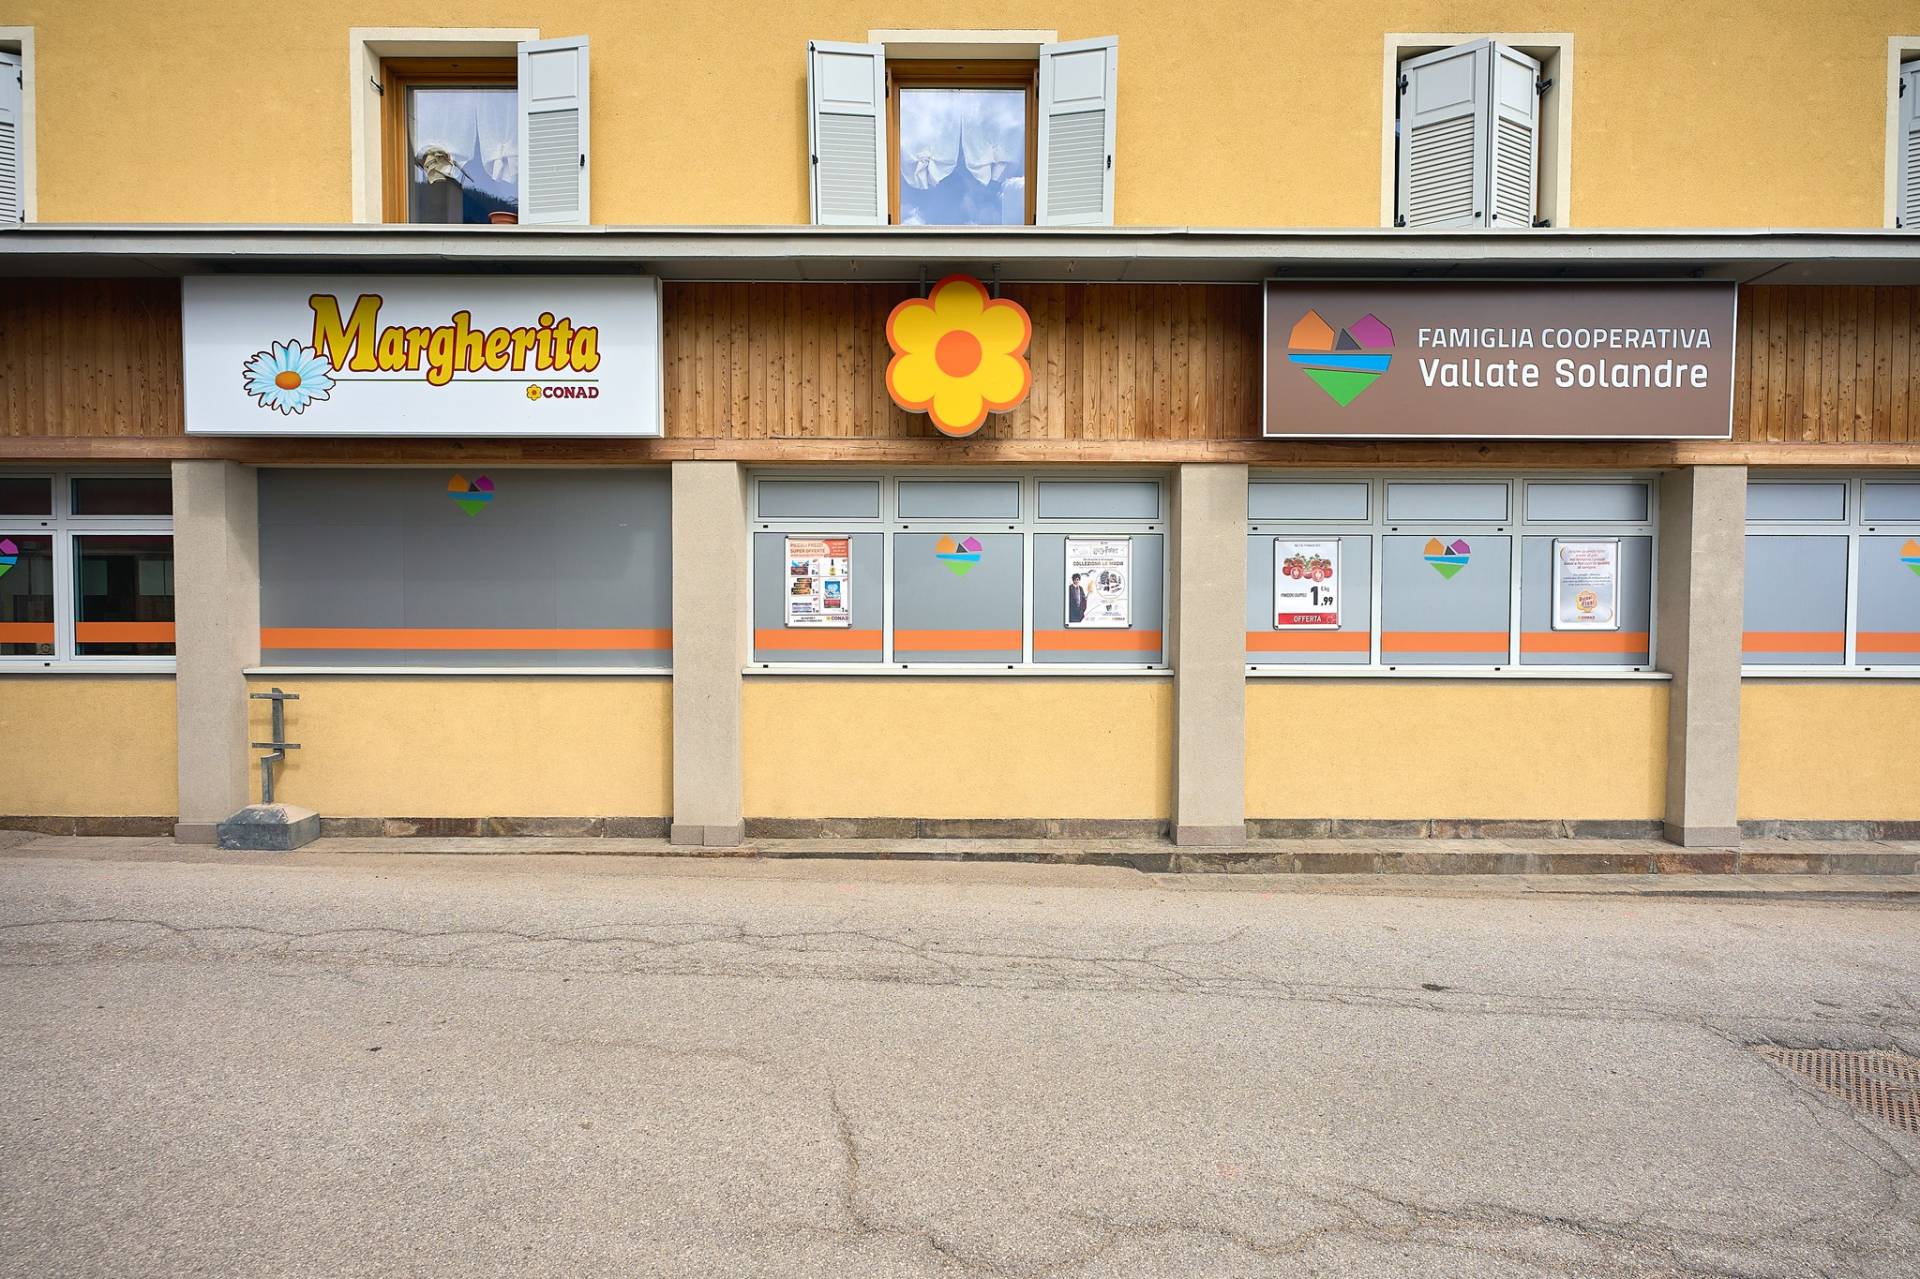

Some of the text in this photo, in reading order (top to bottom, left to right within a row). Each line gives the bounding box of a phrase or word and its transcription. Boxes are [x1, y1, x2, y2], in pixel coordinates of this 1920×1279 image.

[308, 293, 601, 387] Margherita
[1417, 327, 1713, 350] FAMIGLIA COOPERATIVA
[1417, 357, 1709, 388] Vallate Solandre
[542, 386, 600, 399] CONAD
[1293, 615, 1322, 623] OFFERTA
